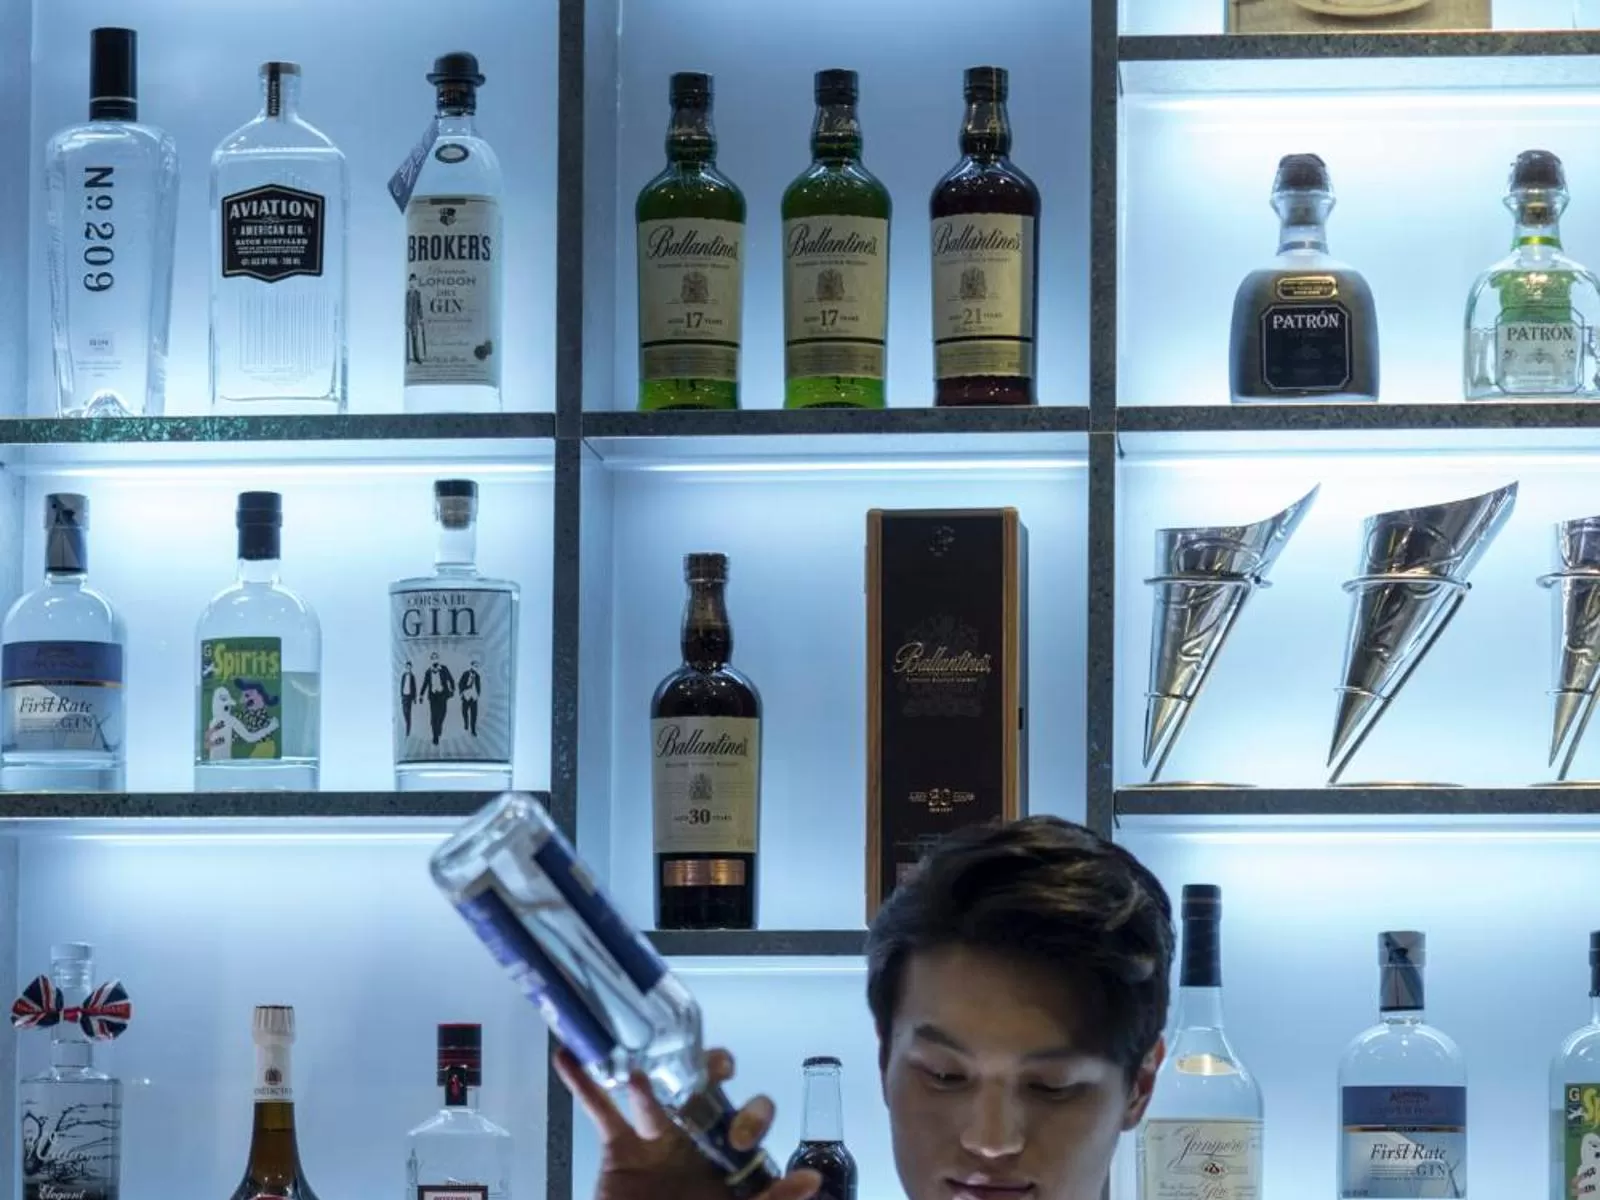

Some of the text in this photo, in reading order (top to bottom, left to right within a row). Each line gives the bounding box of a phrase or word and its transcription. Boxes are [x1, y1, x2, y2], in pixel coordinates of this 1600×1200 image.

[230, 199, 316, 219] AVIATION
[240, 225, 285, 236] AMERICAN
[408, 233, 492, 263] BROKER'S
[647, 224, 739, 260] Ballantine's
[786, 223, 878, 259] Ballantine's
[933, 223, 1023, 257] Ballantine's
[83, 222, 115, 292] 209
[418, 276, 477, 287] LONDON
[430, 298, 464, 313] GIN
[685, 311, 705, 329] 17
[820, 309, 840, 327] 17
[963, 308, 983, 325] 21
[1273, 310, 1340, 329] PATRÓN
[893, 642, 991, 673] Ballantine's
[20, 696, 93, 713] First Rate
[656, 724, 749, 758] Ballantine's
[688, 808, 711, 825] 30
[1370, 1143, 1447, 1160] First Rate
[1416, 1164, 1445, 1176] GIN
